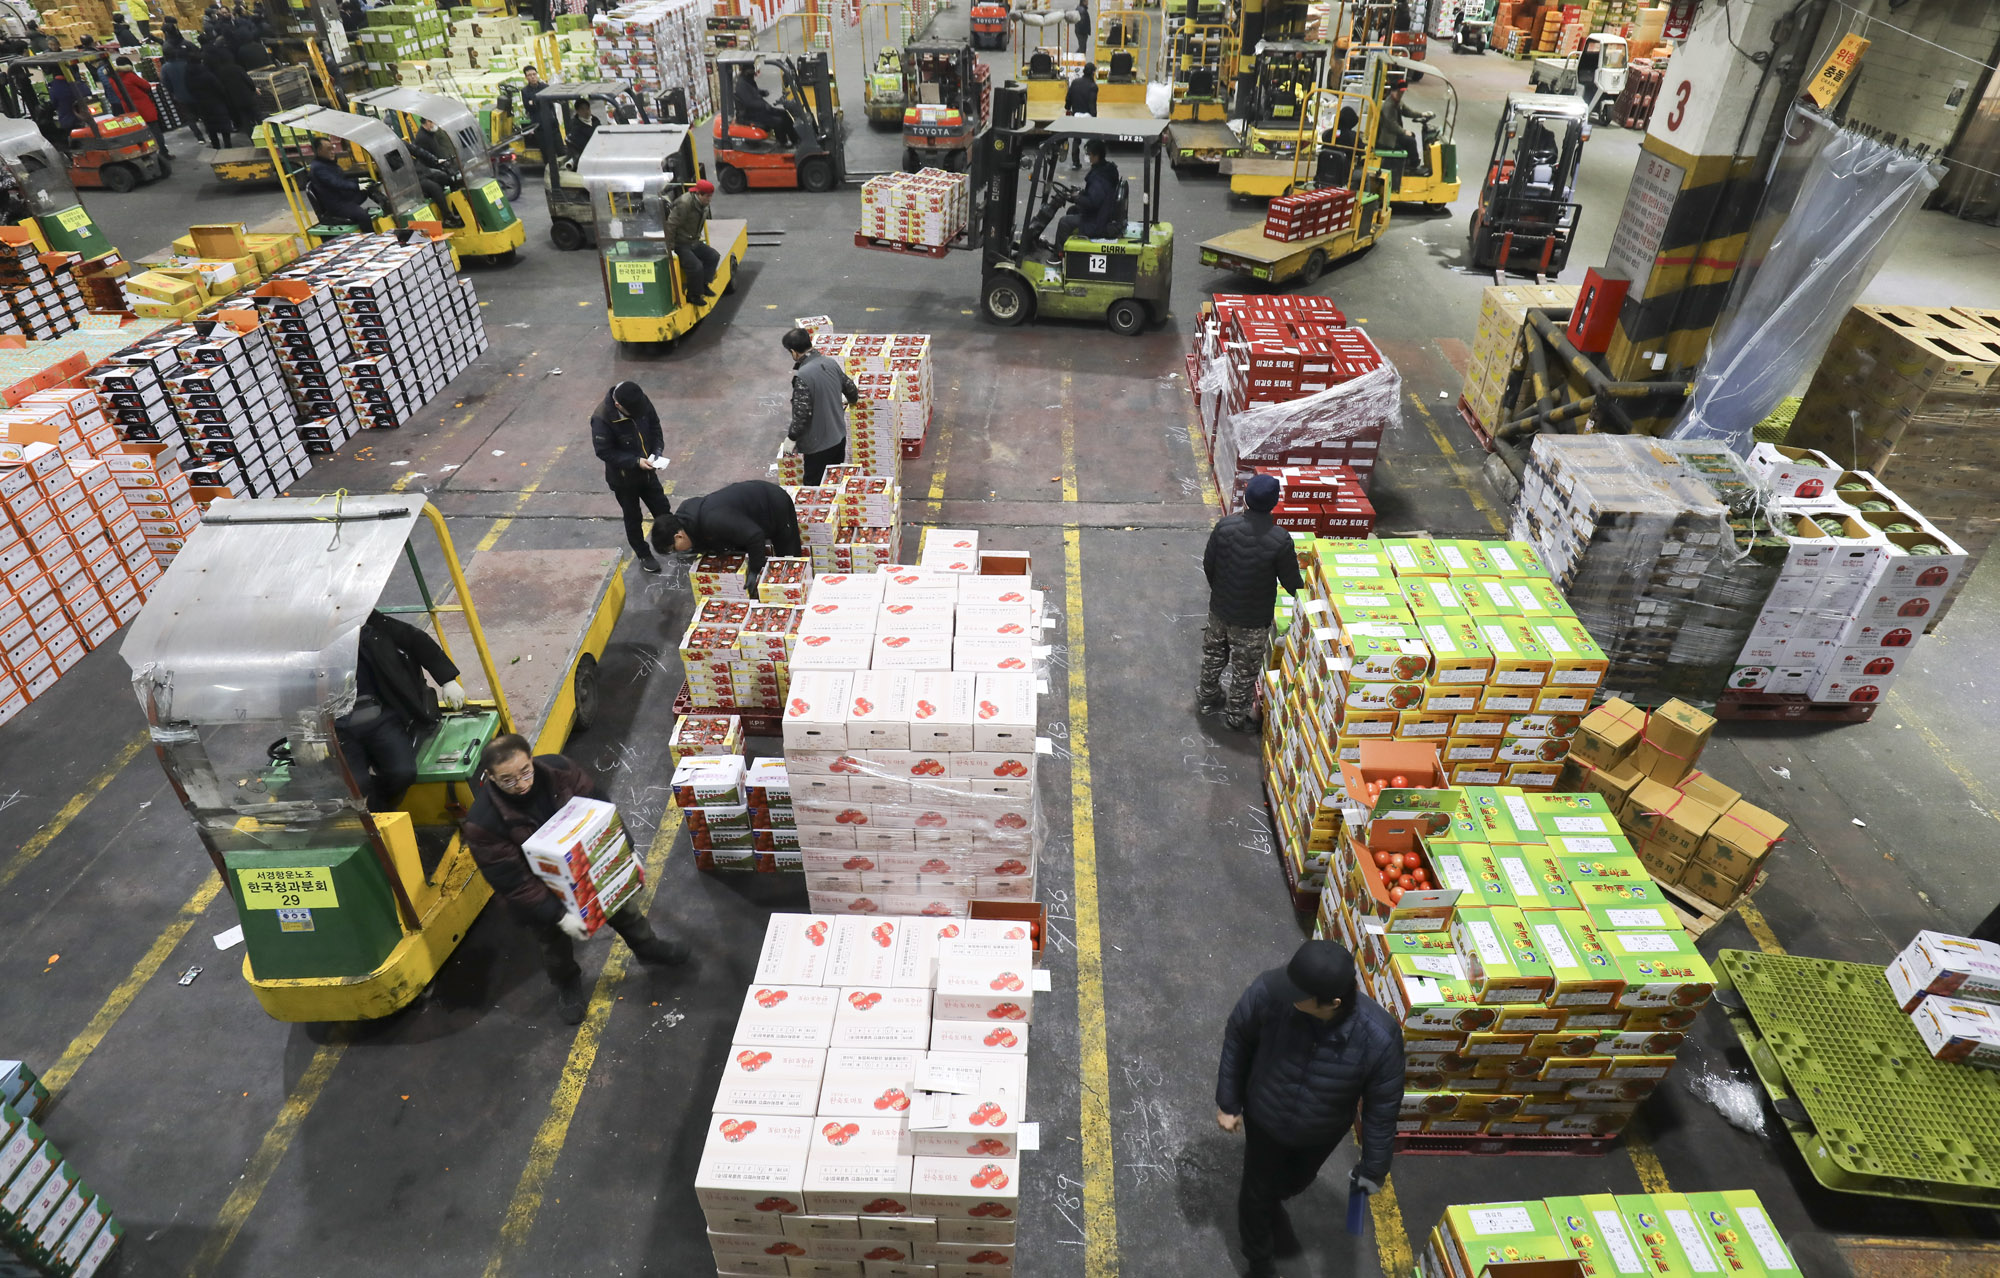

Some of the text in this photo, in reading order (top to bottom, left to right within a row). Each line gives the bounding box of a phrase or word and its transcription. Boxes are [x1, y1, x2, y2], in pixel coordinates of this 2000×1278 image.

[1824, 65, 1846, 82] 충돌
[1668, 80, 1691, 132] 3
[913, 127, 950, 136] TOYOTA
[1101, 245, 1126, 254] CLARK
[1091, 258, 1105, 270] 12
[1275, 360, 1294, 368] 토마토
[1254, 380, 1292, 388] 이길호 토마토
[1365, 666, 1390, 674] 토마토
[1361, 694, 1386, 702] 토마토
[1658, 826, 1689, 850] 청경채
[1645, 852, 1676, 875] 청경채
[257, 870, 314, 880] 서경항운노조
[1599, 869, 1630, 877] 토마토
[248, 880, 328, 893] 한국청과분회
[282, 894, 300, 906] 29
[1513, 922, 1534, 948] 토마토
[1581, 924, 1602, 952] 토마토
[1422, 942, 1454, 950] 토마토
[1660, 968, 1695, 978] 토마토
[1446, 994, 1476, 1003] 토마토
[923, 1173, 960, 1182] 완숙토마토
[1053, 1174, 1086, 1245] 1/89
[1570, 1236, 1596, 1276] 토마토
[1642, 1233, 1670, 1274] 토마토
[1714, 1230, 1743, 1272] 토마토
